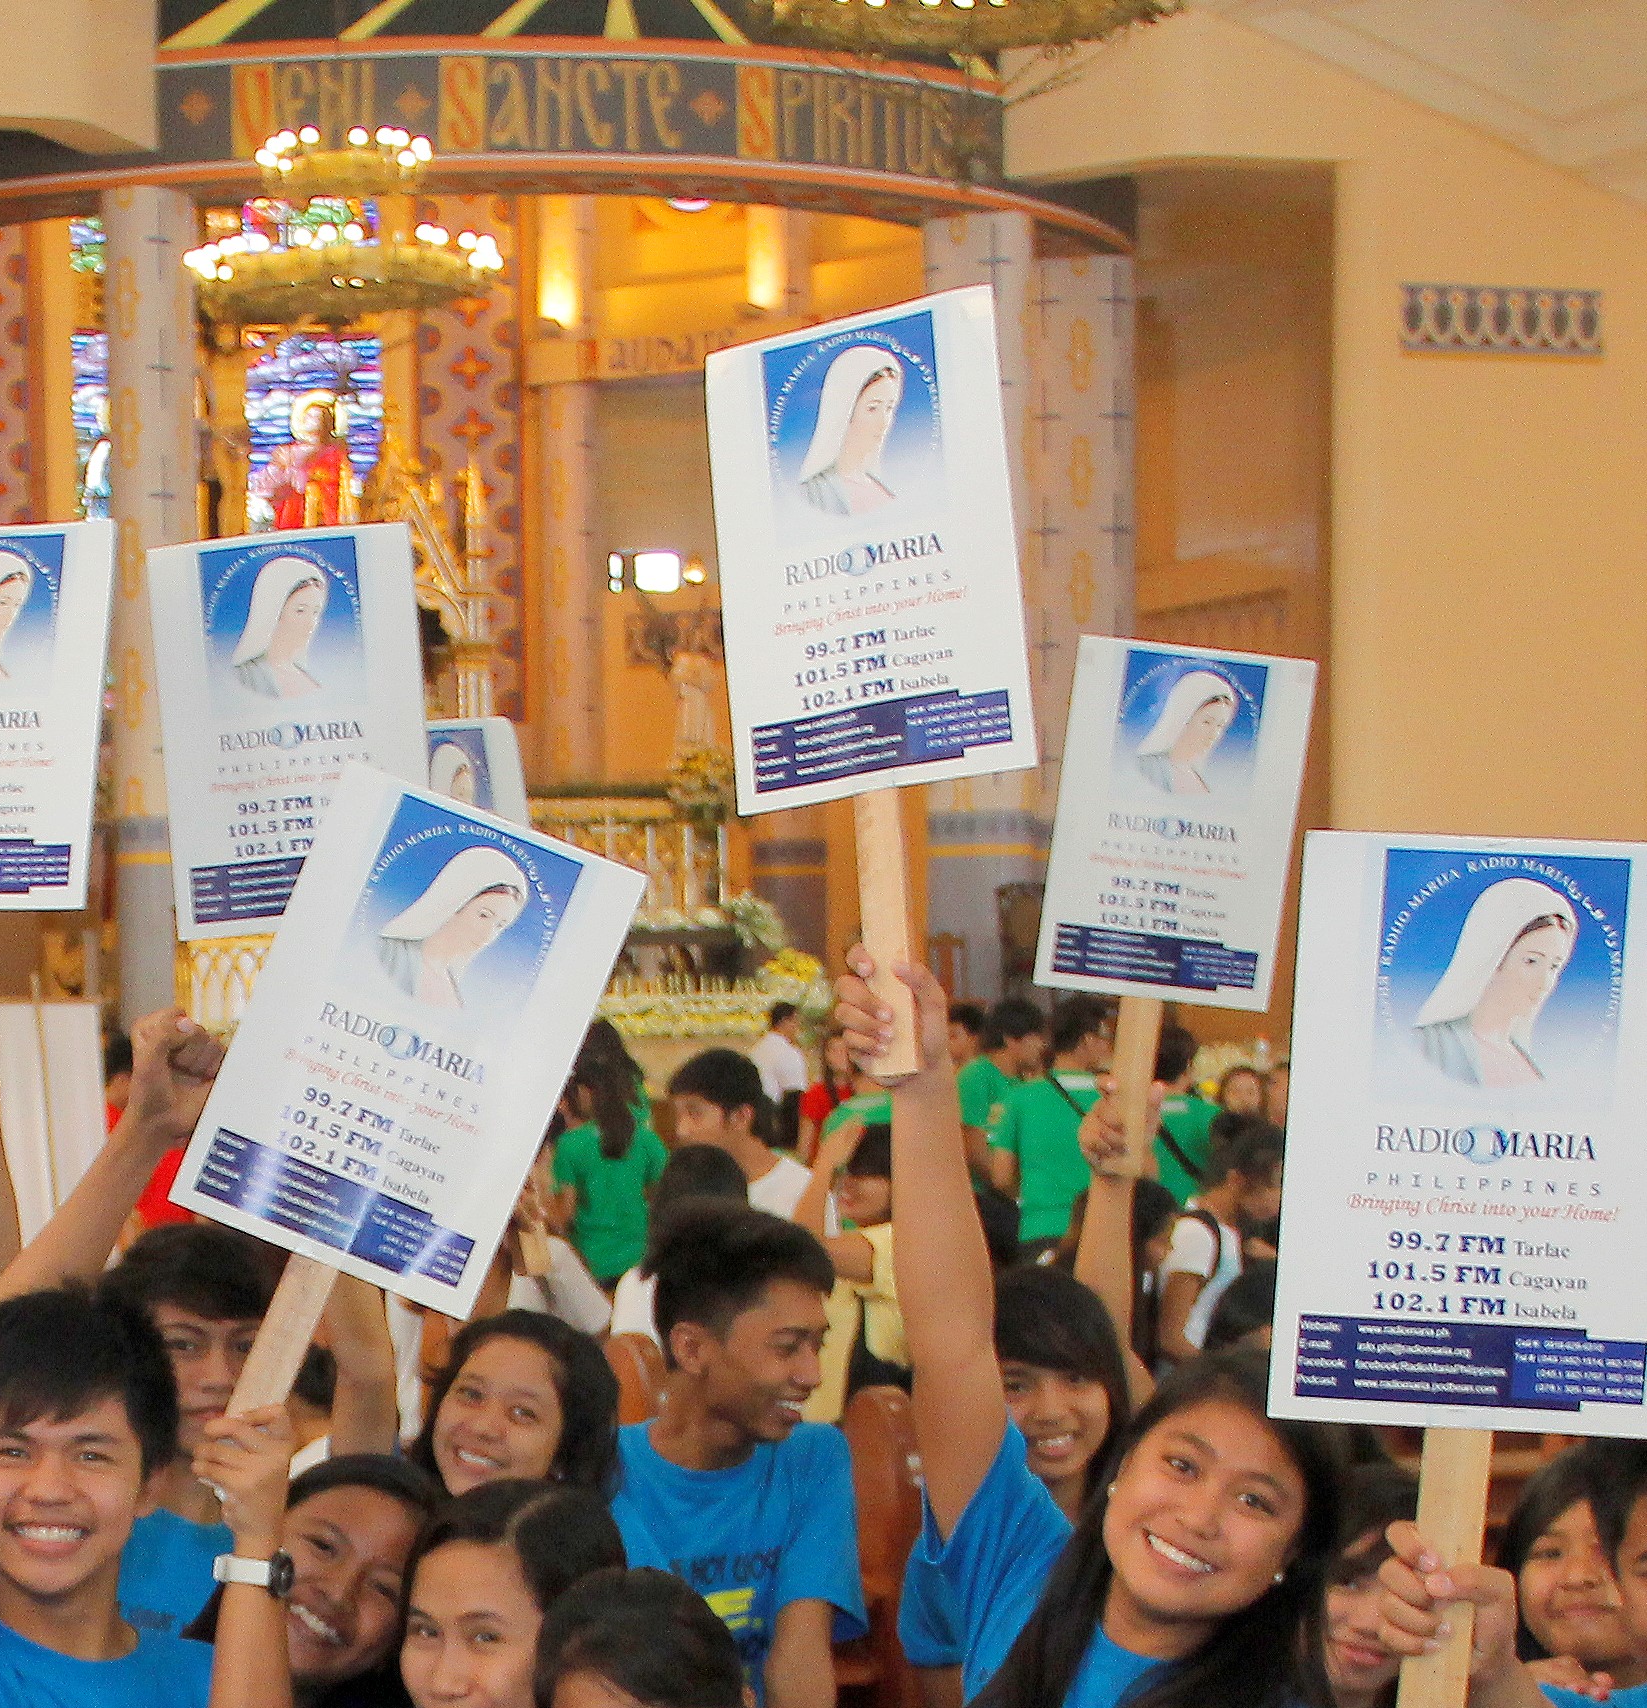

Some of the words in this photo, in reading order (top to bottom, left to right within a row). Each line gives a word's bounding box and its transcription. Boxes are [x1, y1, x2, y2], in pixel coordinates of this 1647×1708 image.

[785, 550, 854, 587] RADIO
[862, 530, 942, 569] MARIA
[784, 567, 950, 614] PHILIPPINES
[804, 637, 847, 660] 99.7
[852, 629, 887, 650] FM
[793, 661, 848, 686] 101.5
[852, 654, 888, 675] FM
[800, 685, 855, 710] 102.1
[859, 678, 895, 699] FM
[318, 1001, 398, 1051] RADIO
[303, 1035, 479, 1113] PHILIPPINES
[303, 1086, 353, 1118] 99.7
[355, 1107, 394, 1135] FM
[343, 1129, 383, 1157] FM
[1376, 1125, 1475, 1157] RADIO
[1490, 1128, 1596, 1161] MARIA
[340, 1155, 379, 1183] FM
[1367, 1172, 1600, 1197] PHILIPPINES
[1388, 1230, 1451, 1253] 99.7
[1458, 1234, 1506, 1255] FM
[1513, 1240, 1570, 1259] Tarlac
[1367, 1260, 1446, 1283] 101.5
[1453, 1265, 1501, 1285] FM
[1508, 1271, 1587, 1293] Cagayan
[1372, 1291, 1449, 1314] 102.1
[1459, 1296, 1507, 1317] FM
[1514, 1302, 1577, 1321] Isabela
